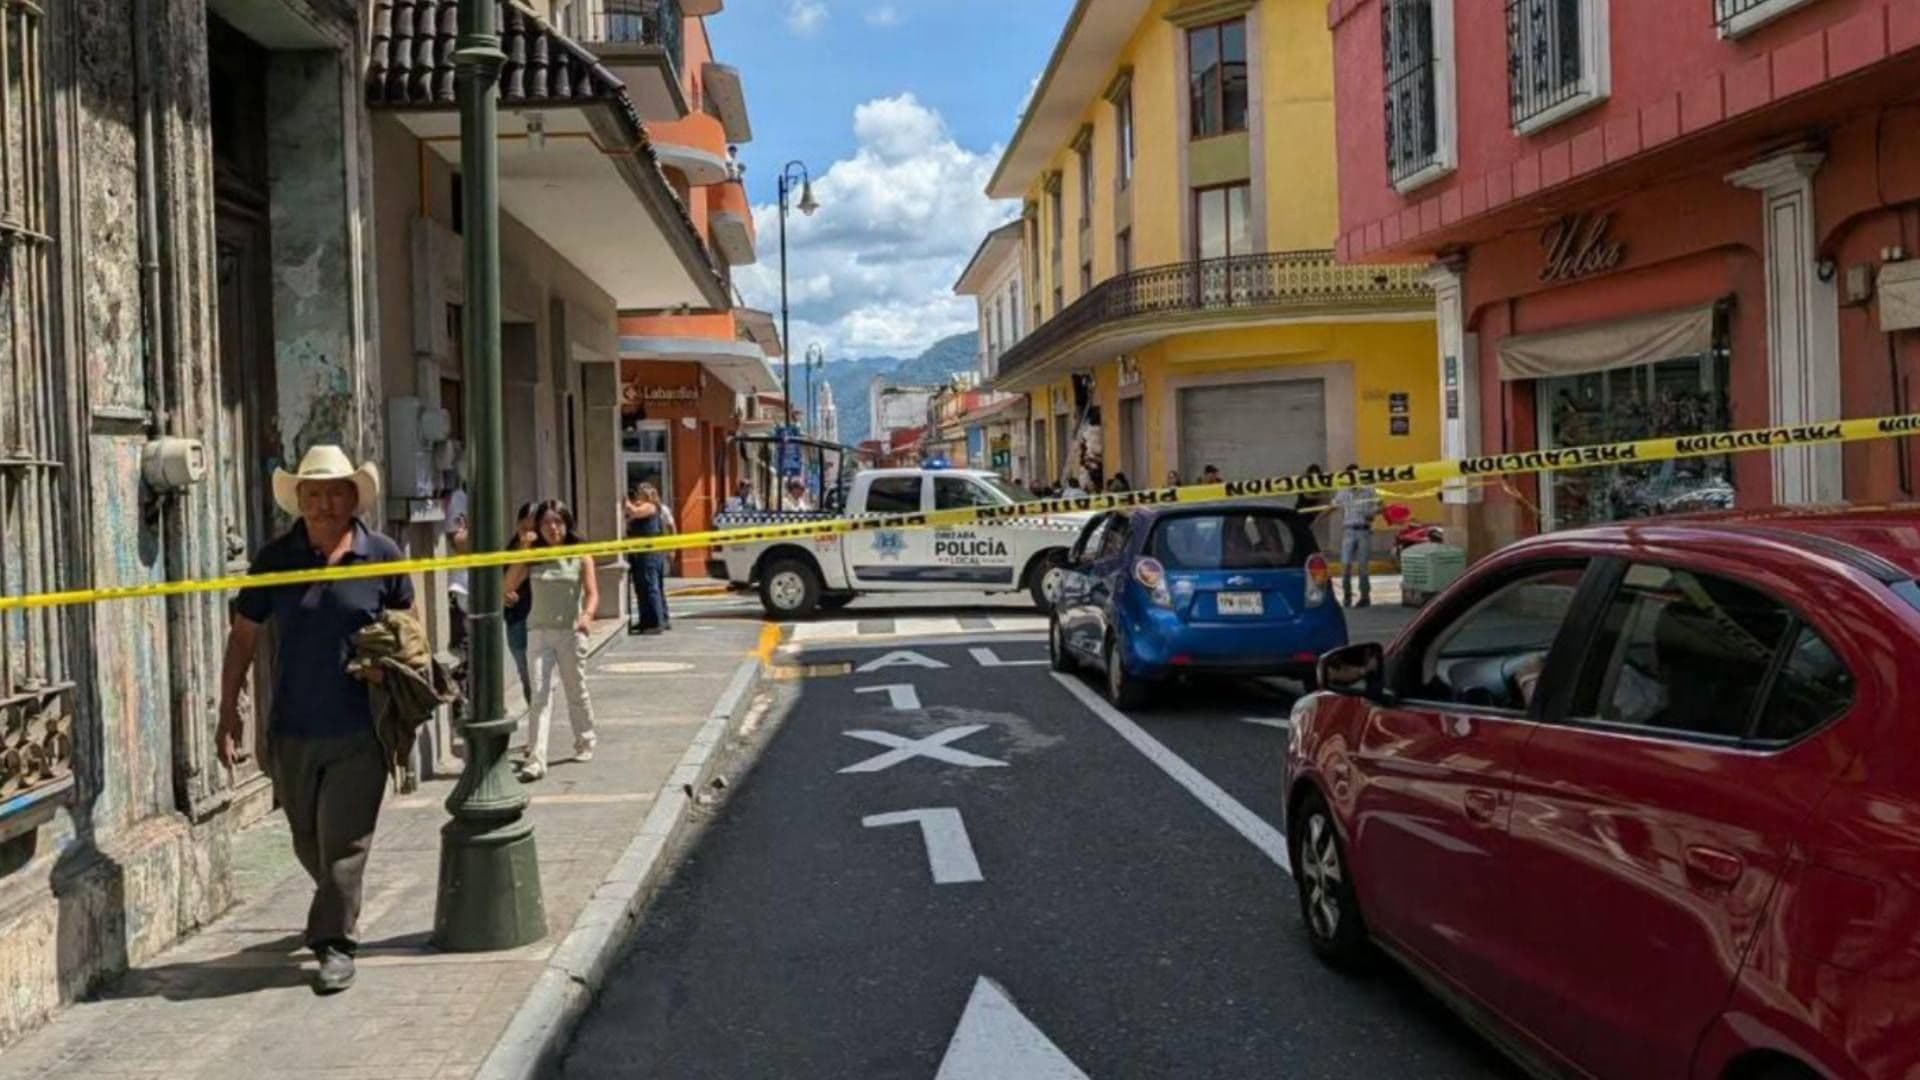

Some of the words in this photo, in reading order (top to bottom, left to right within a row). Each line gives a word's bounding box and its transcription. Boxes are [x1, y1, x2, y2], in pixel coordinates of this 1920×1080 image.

[1675, 424, 1842, 453] PRECAUCION
[1459, 445, 1636, 474] PRECAUCION
[1225, 466, 1416, 496] PRECAUCION
[935, 538, 1008, 556] POLICÍA
